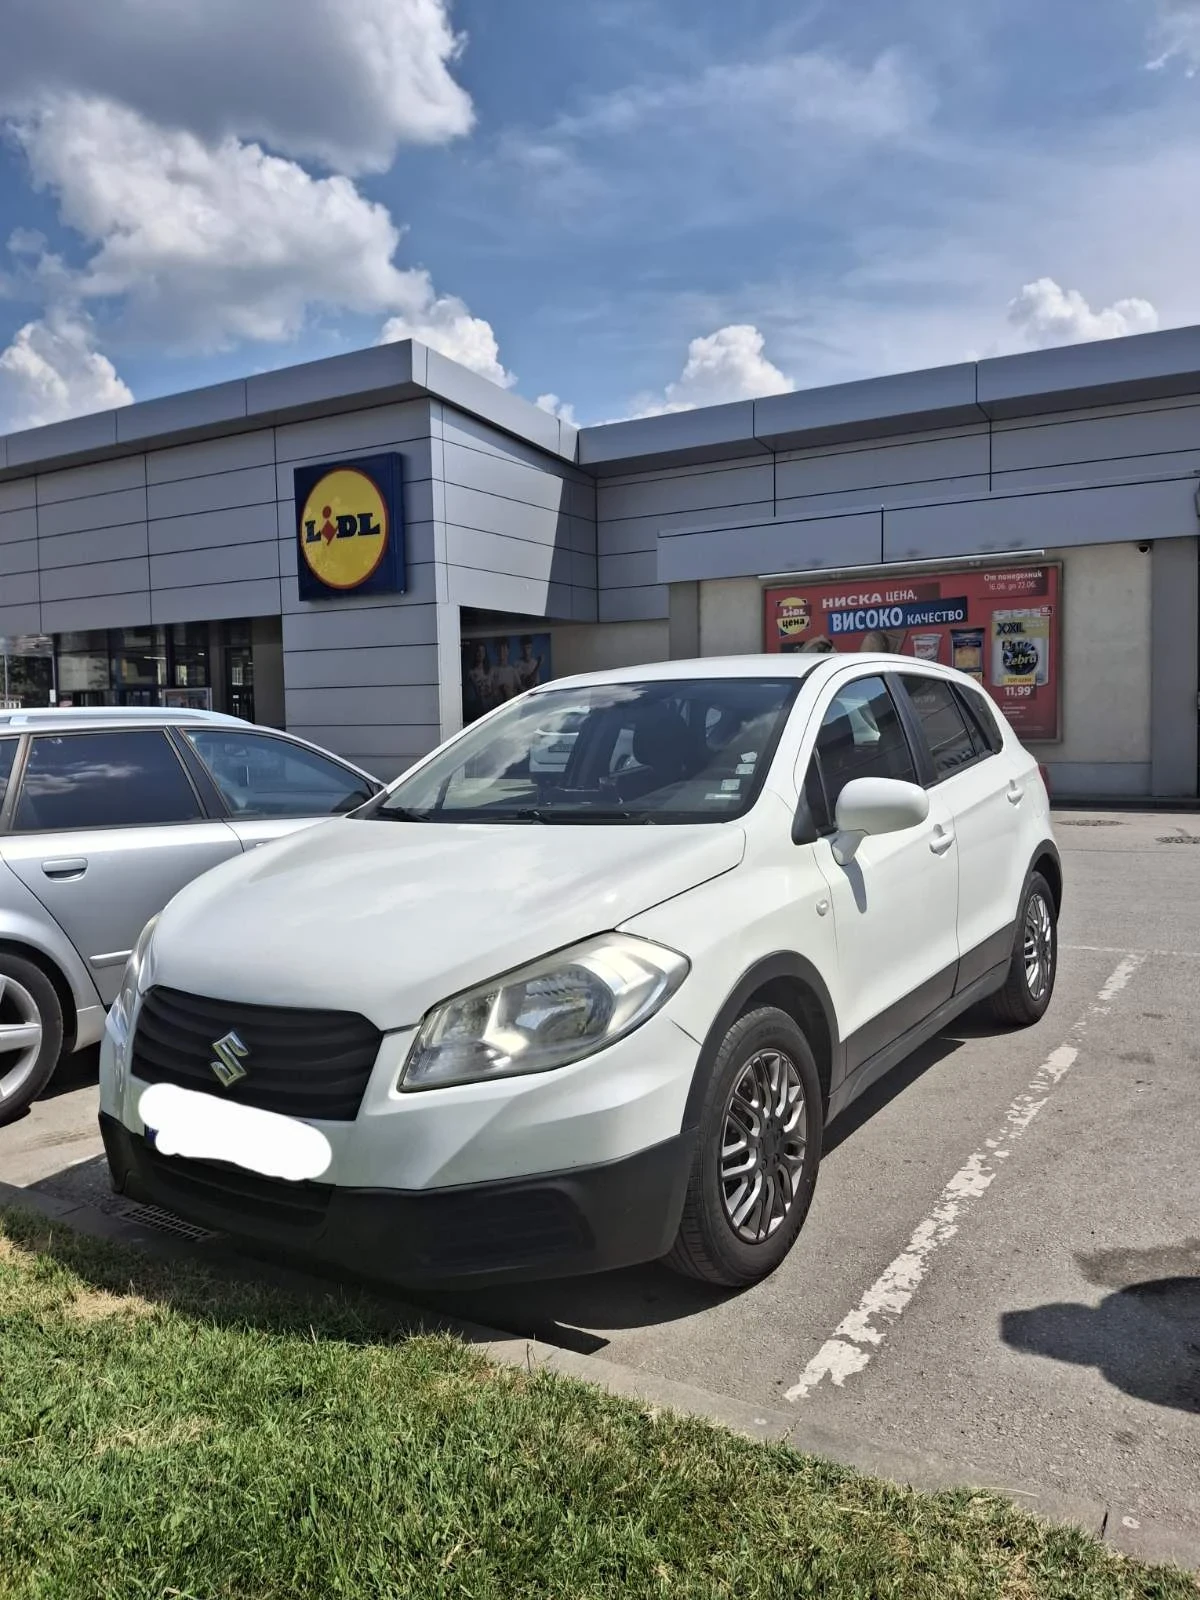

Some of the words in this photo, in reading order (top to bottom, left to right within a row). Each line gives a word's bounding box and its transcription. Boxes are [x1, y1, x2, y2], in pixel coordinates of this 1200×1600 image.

[822, 592, 882, 608] НИСКА
[886, 589, 917, 602] ЦЕНА,
[782, 617, 805, 630] цена
[831, 606, 903, 632] ВИСОКО
[907, 609, 964, 625] КАЧЕСТВО
